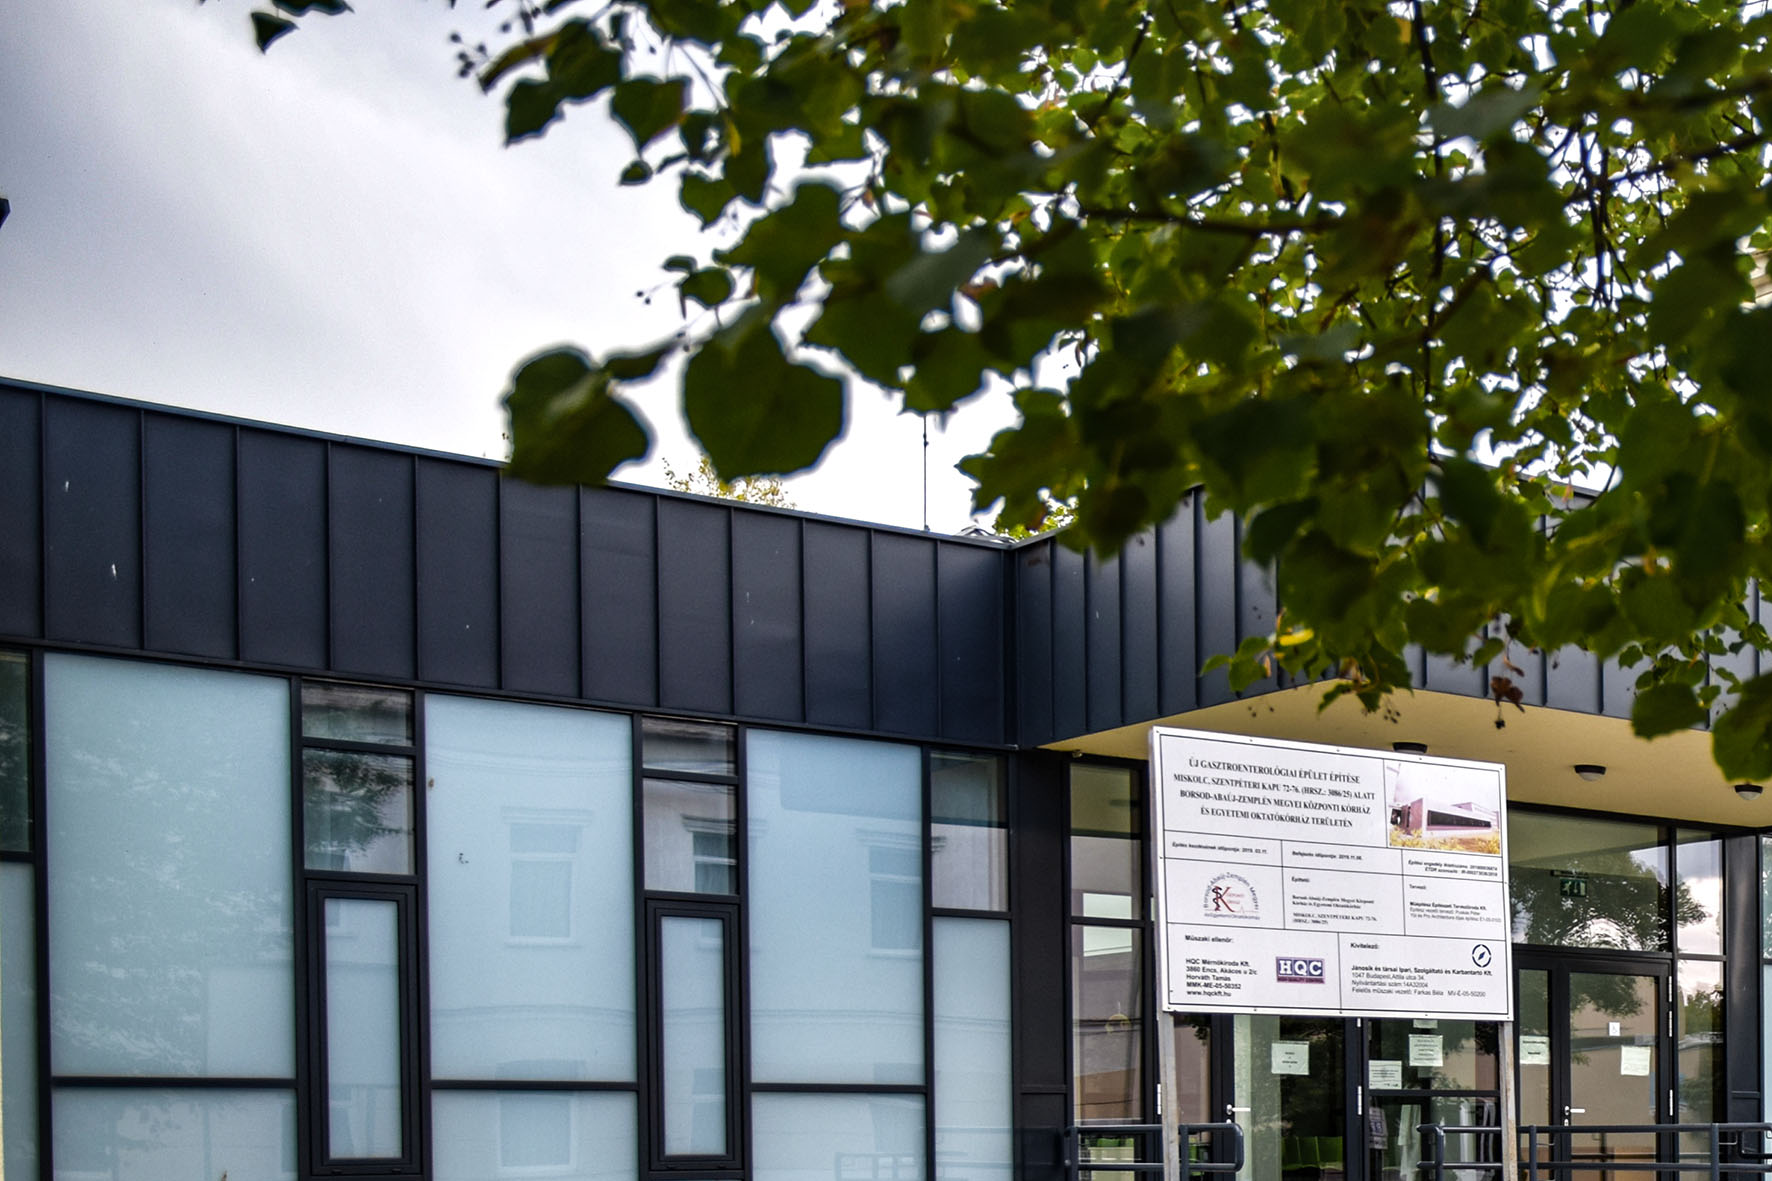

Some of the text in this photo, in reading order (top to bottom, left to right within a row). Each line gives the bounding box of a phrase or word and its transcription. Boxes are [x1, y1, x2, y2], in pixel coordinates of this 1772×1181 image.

[1189, 757, 1359, 784] ÚJ GASZTROENTEROLÓGIAI ÉPÜLET ÉPÍTÉSE
[1212, 778, 1260, 789] SZENTPÉTERI
[1262, 783, 1280, 791] KAPU
[1180, 790, 1370, 814] BORSOD-ABAÚJ-ZEMPLÉN MEGYEI KÖZPONTI KÓRHÁZ
[1201, 807, 1352, 827] ÉS EGYETEMI OKTATÓKÓRHÁZ TERÜLETÉN
[1279, 960, 1322, 976] HQC
